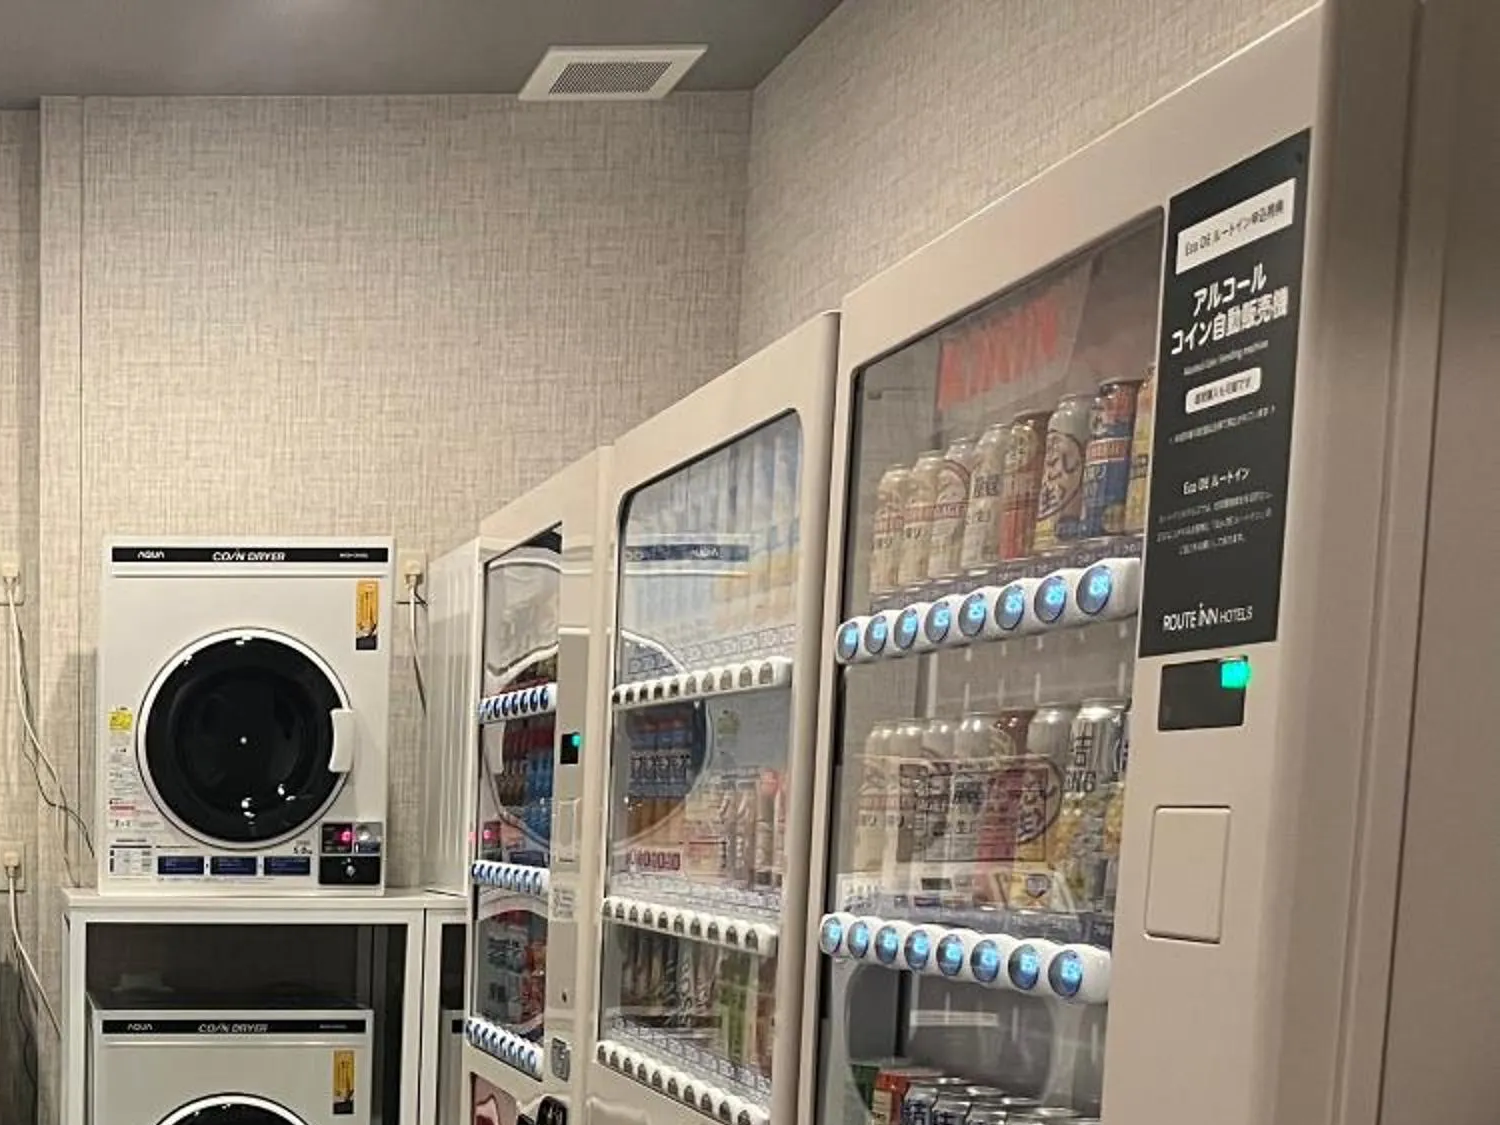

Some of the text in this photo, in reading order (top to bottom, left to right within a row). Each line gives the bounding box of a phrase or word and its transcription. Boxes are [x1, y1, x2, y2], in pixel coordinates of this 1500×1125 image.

[1193, 262, 1267, 317] アルコール
[1170, 286, 1289, 355] コイン自動販売機
[246, 550, 287, 562] DRYER
[1163, 610, 1197, 631] ROUTE
[1219, 606, 1254, 624] HOTELS
